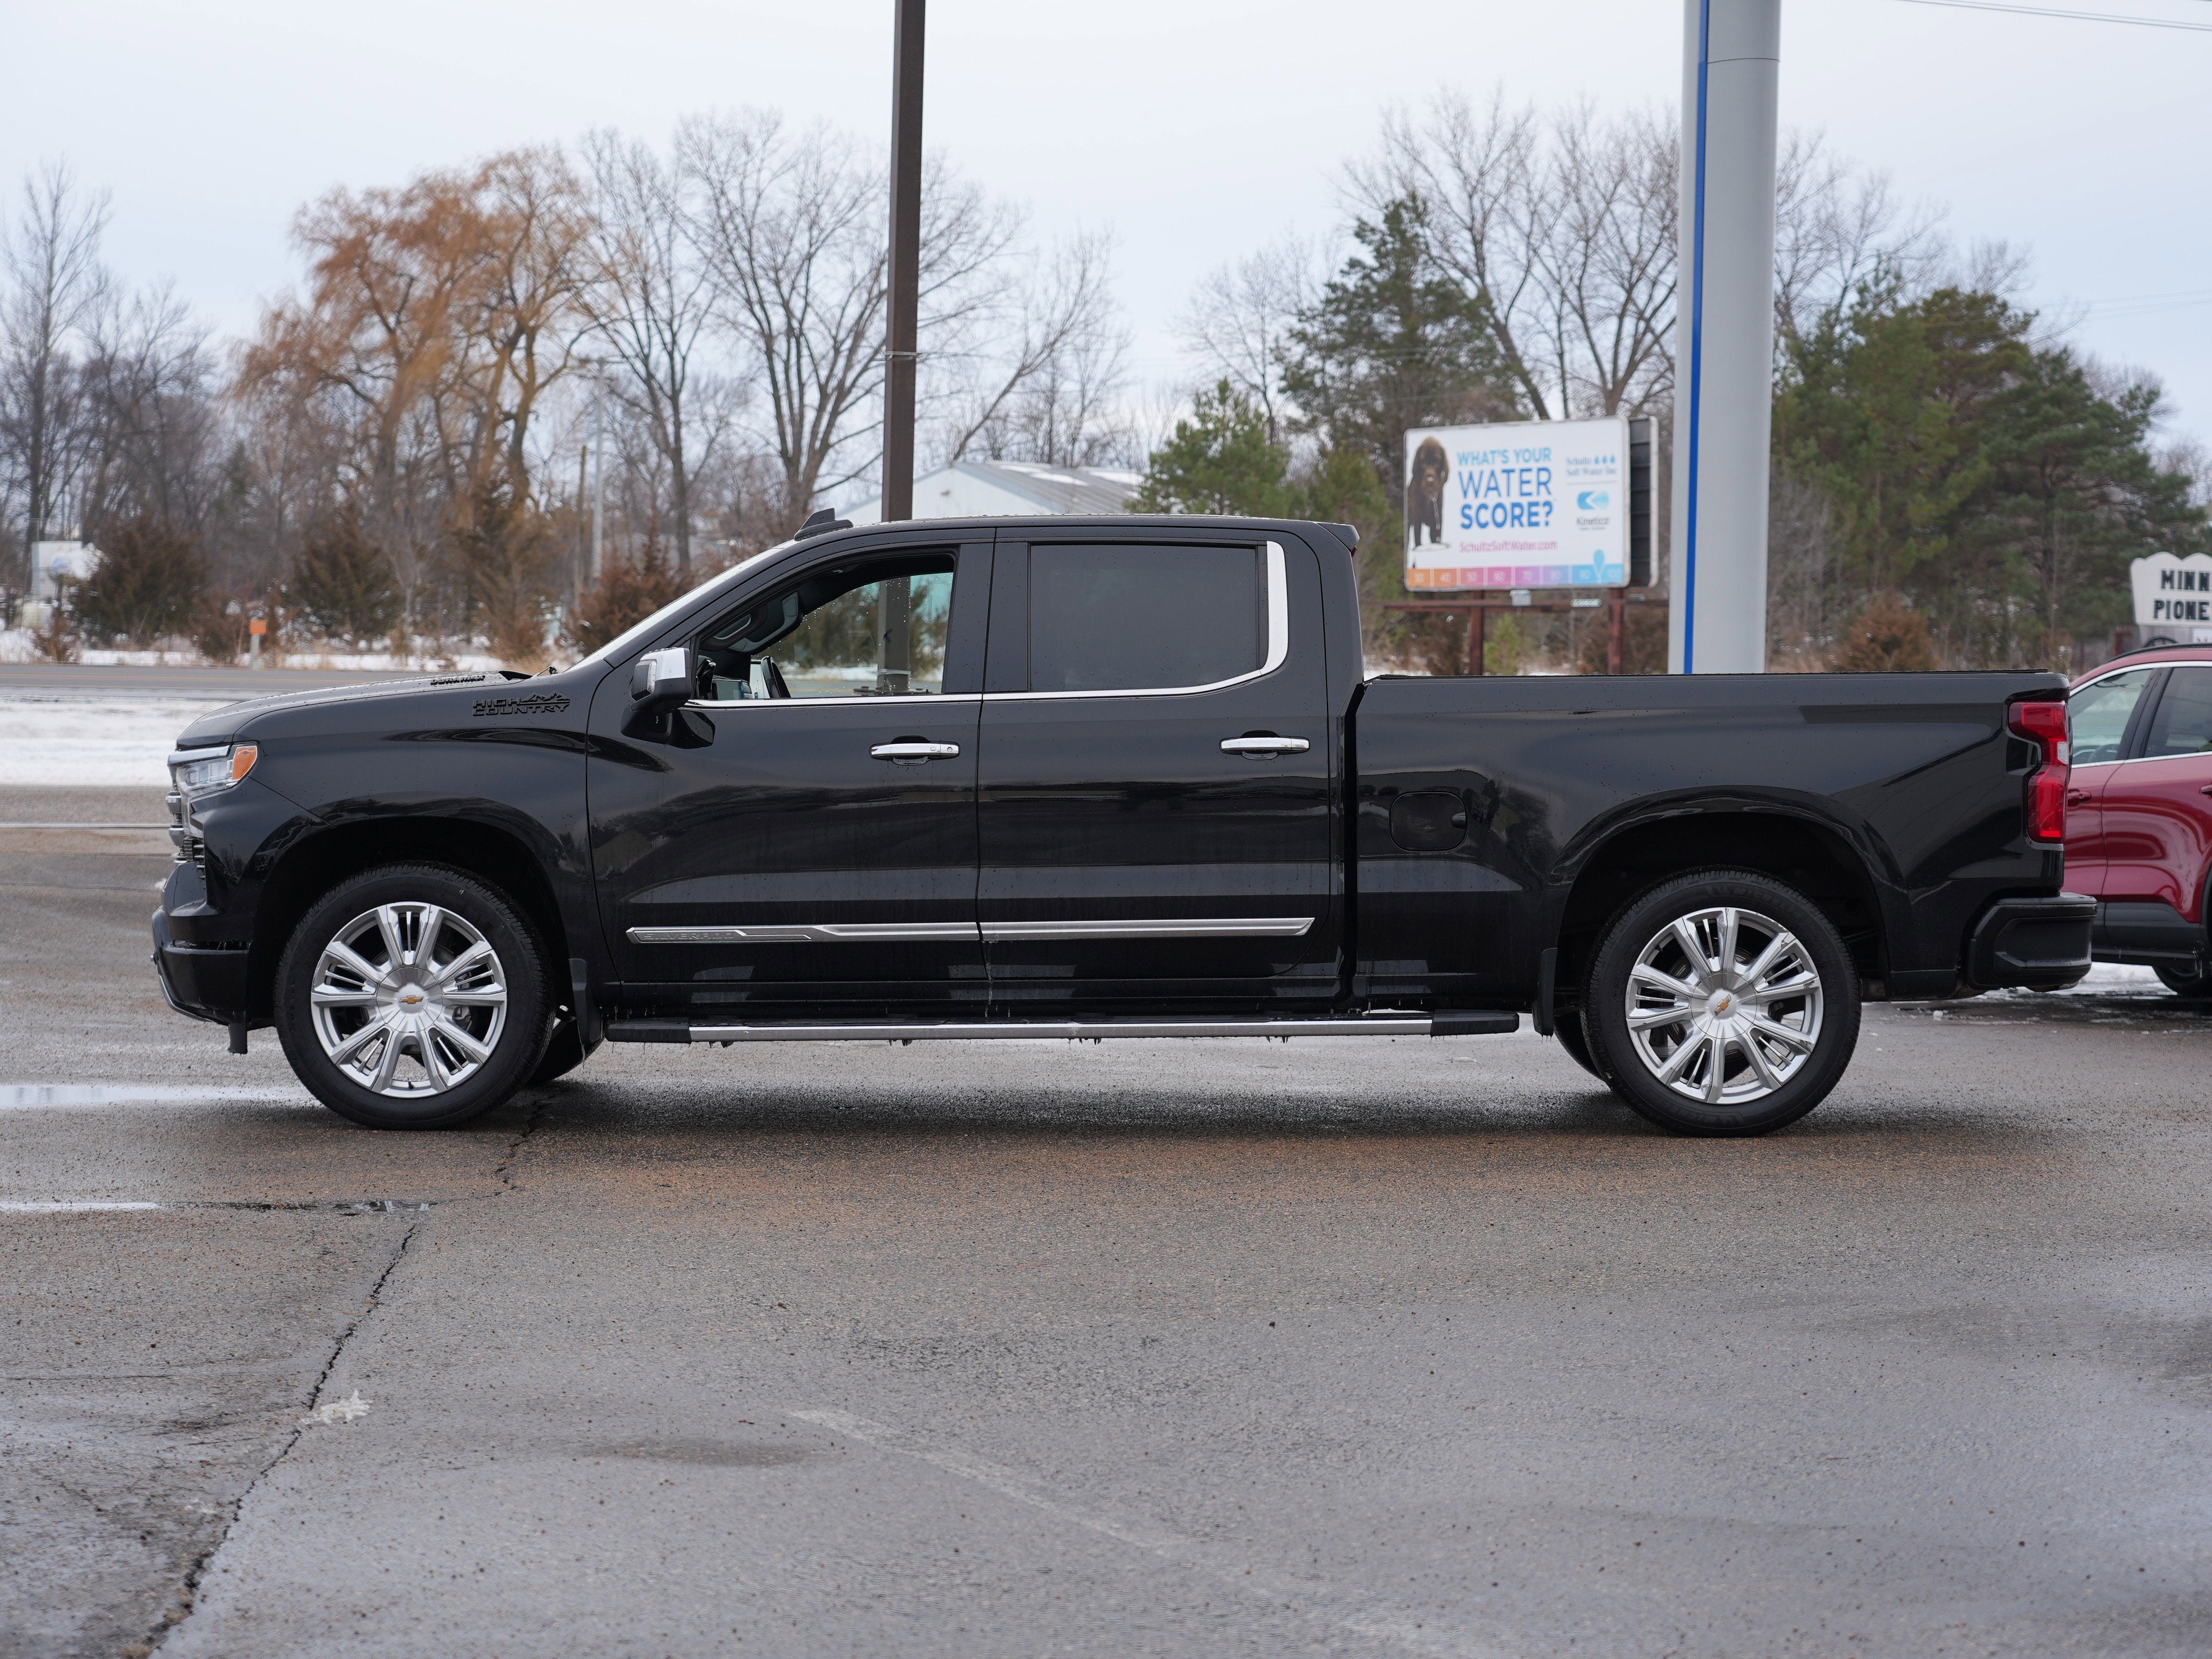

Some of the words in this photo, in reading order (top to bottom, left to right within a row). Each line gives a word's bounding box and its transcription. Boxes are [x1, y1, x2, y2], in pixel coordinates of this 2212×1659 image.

[1458, 449, 1509, 465] WHAT'S
[1514, 447, 1551, 463] YOUR
[1459, 467, 1551, 498] WATER
[1461, 500, 1553, 529] SCORE?
[473, 698, 521, 709] HIGH
[473, 704, 570, 717] COUNTRY
